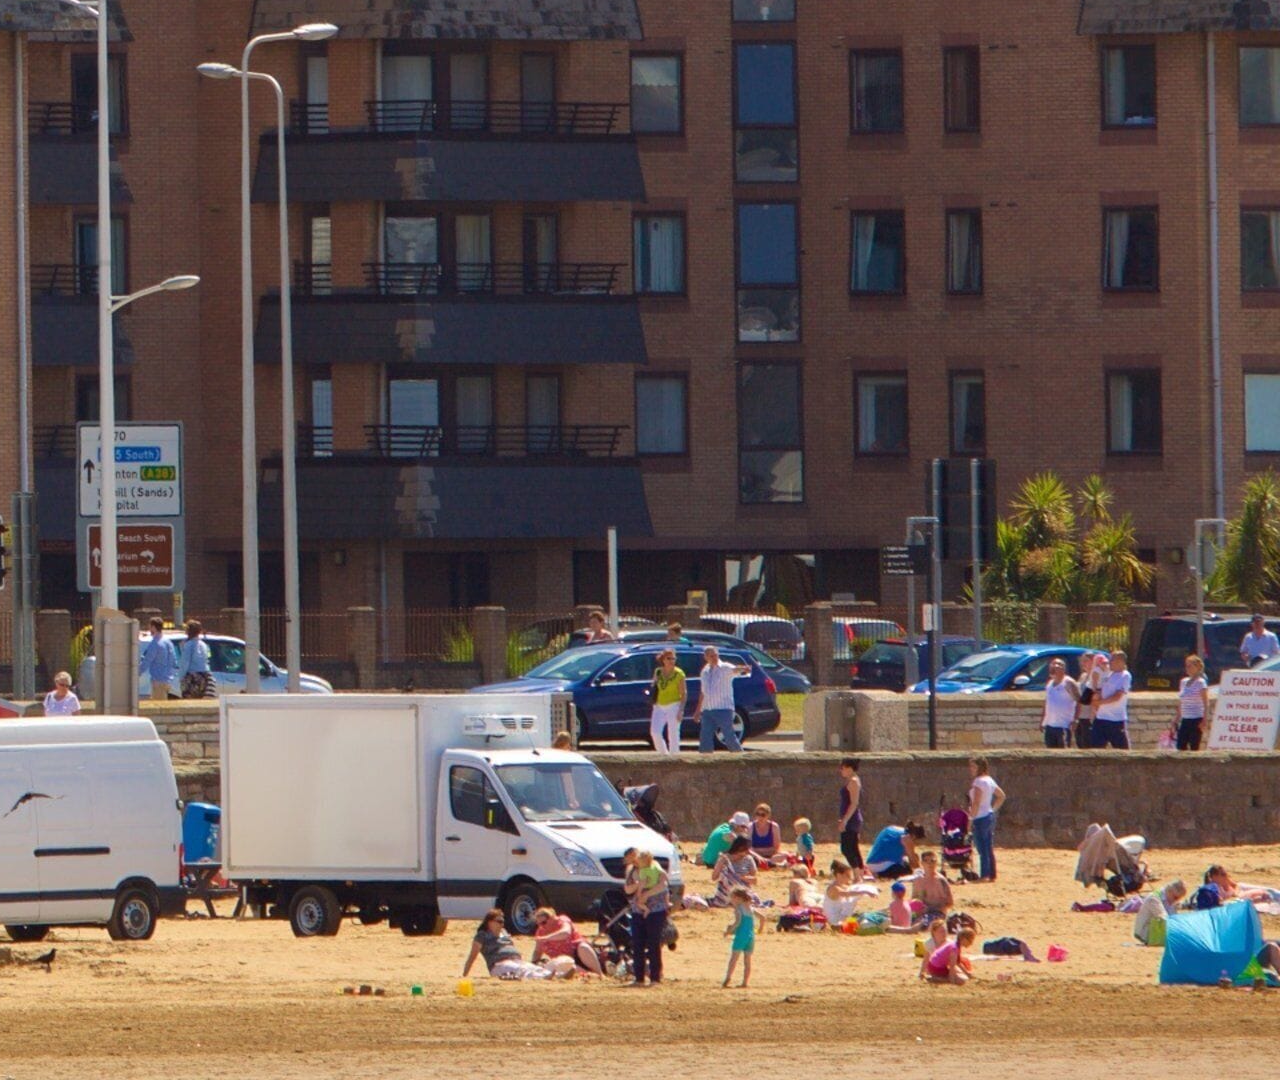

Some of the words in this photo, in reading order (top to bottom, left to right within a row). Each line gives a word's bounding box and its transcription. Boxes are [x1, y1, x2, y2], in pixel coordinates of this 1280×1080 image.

[131, 486, 175, 498] (Sands)
[1232, 677, 1274, 687] CAUTION
[1229, 724, 1258, 733] CLEAR
[1229, 735, 1242, 743] ALL
